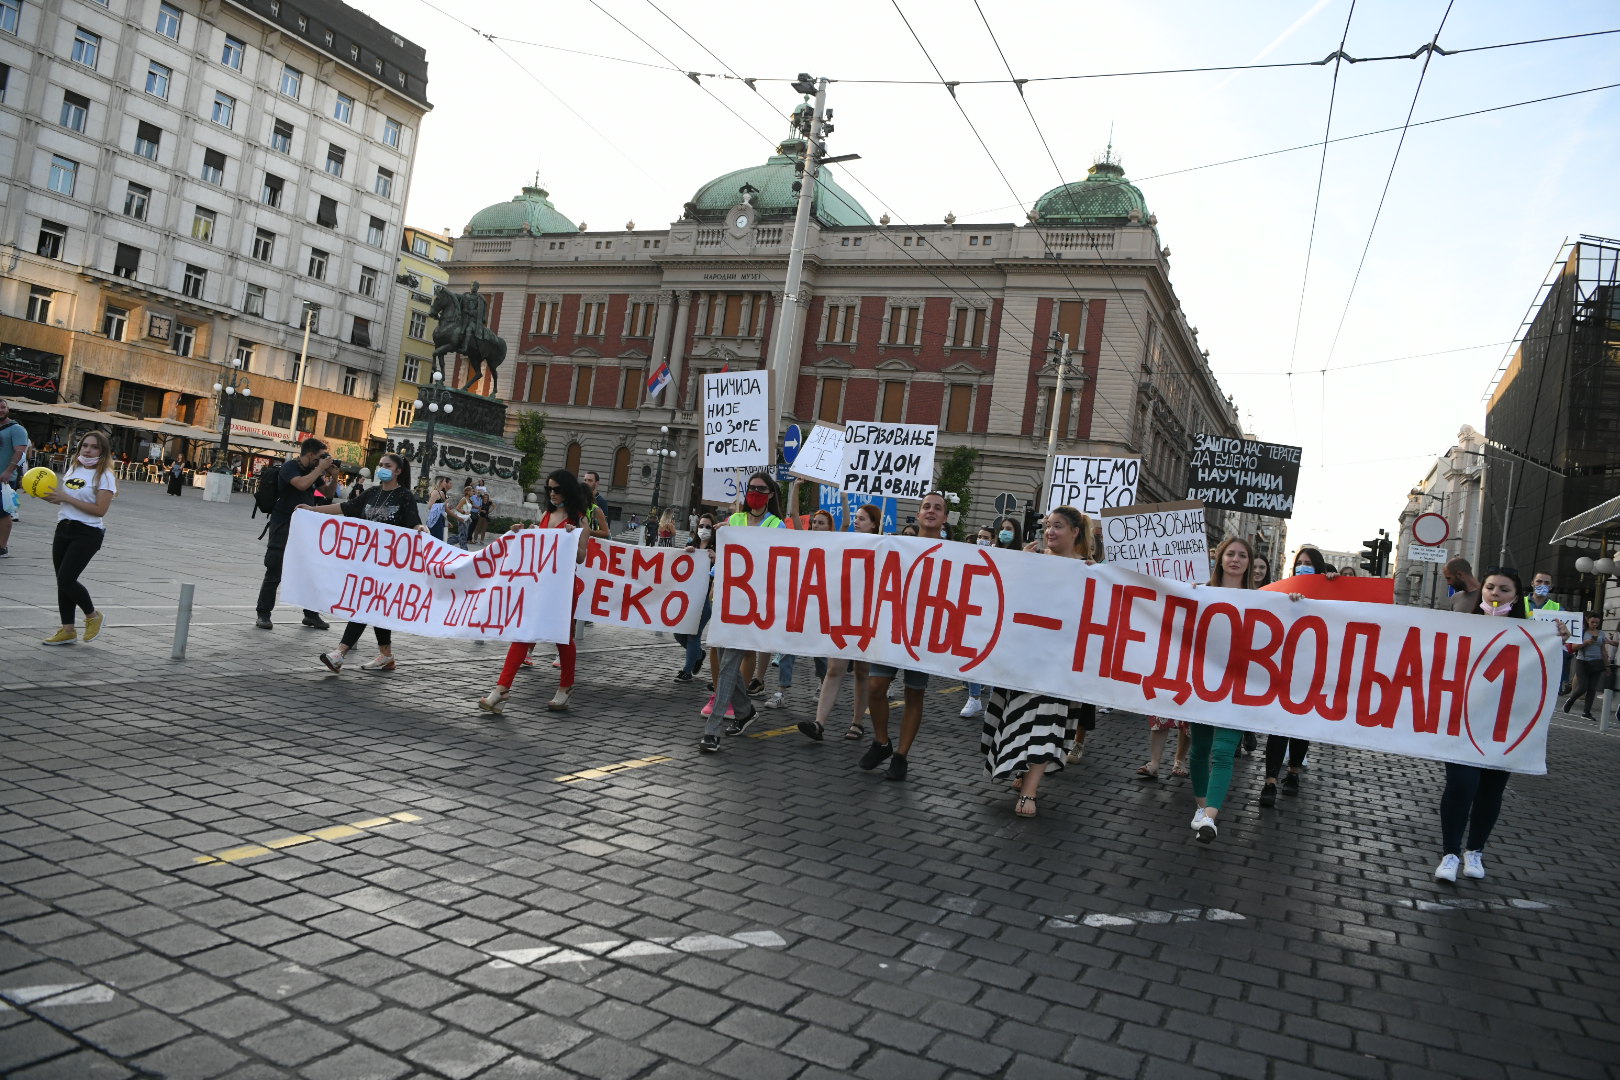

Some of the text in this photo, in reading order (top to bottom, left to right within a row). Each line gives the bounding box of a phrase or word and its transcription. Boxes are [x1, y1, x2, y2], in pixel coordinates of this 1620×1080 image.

[707, 378, 761, 399] НИЧИЈА
[708, 402, 740, 419] НИЈЕ
[705, 419, 760, 435] ДО ЗОРЕ
[845, 425, 935, 446] ОБРАЗОВАЊЕ
[707, 438, 762, 456] ГОРЕЛА.
[1194, 433, 1301, 463] ЗАШТО НАС ТЕРАТЕ
[850, 449, 921, 475] ЛУДОМ
[1053, 457, 1138, 486] НЕЋЕМО
[1190, 451, 1258, 469] ДА БУДЕМО
[844, 473, 930, 496] РАДОВАЊЕ
[1198, 467, 1283, 491] НАУЧНИЦИ
[1048, 484, 1133, 514] ПРЕКО
[1186, 487, 1294, 512] ДРУГИХ ДРЖАВА
[1108, 511, 1205, 543] ОБРАЗОВАЊЕ
[319, 518, 559, 583] ОБРАЗОВАЊЕ ВРЕДИ
[1162, 539, 1206, 556] ДРЖАВА
[330, 573, 524, 636] ДРЖАВА ШТЕДИ
